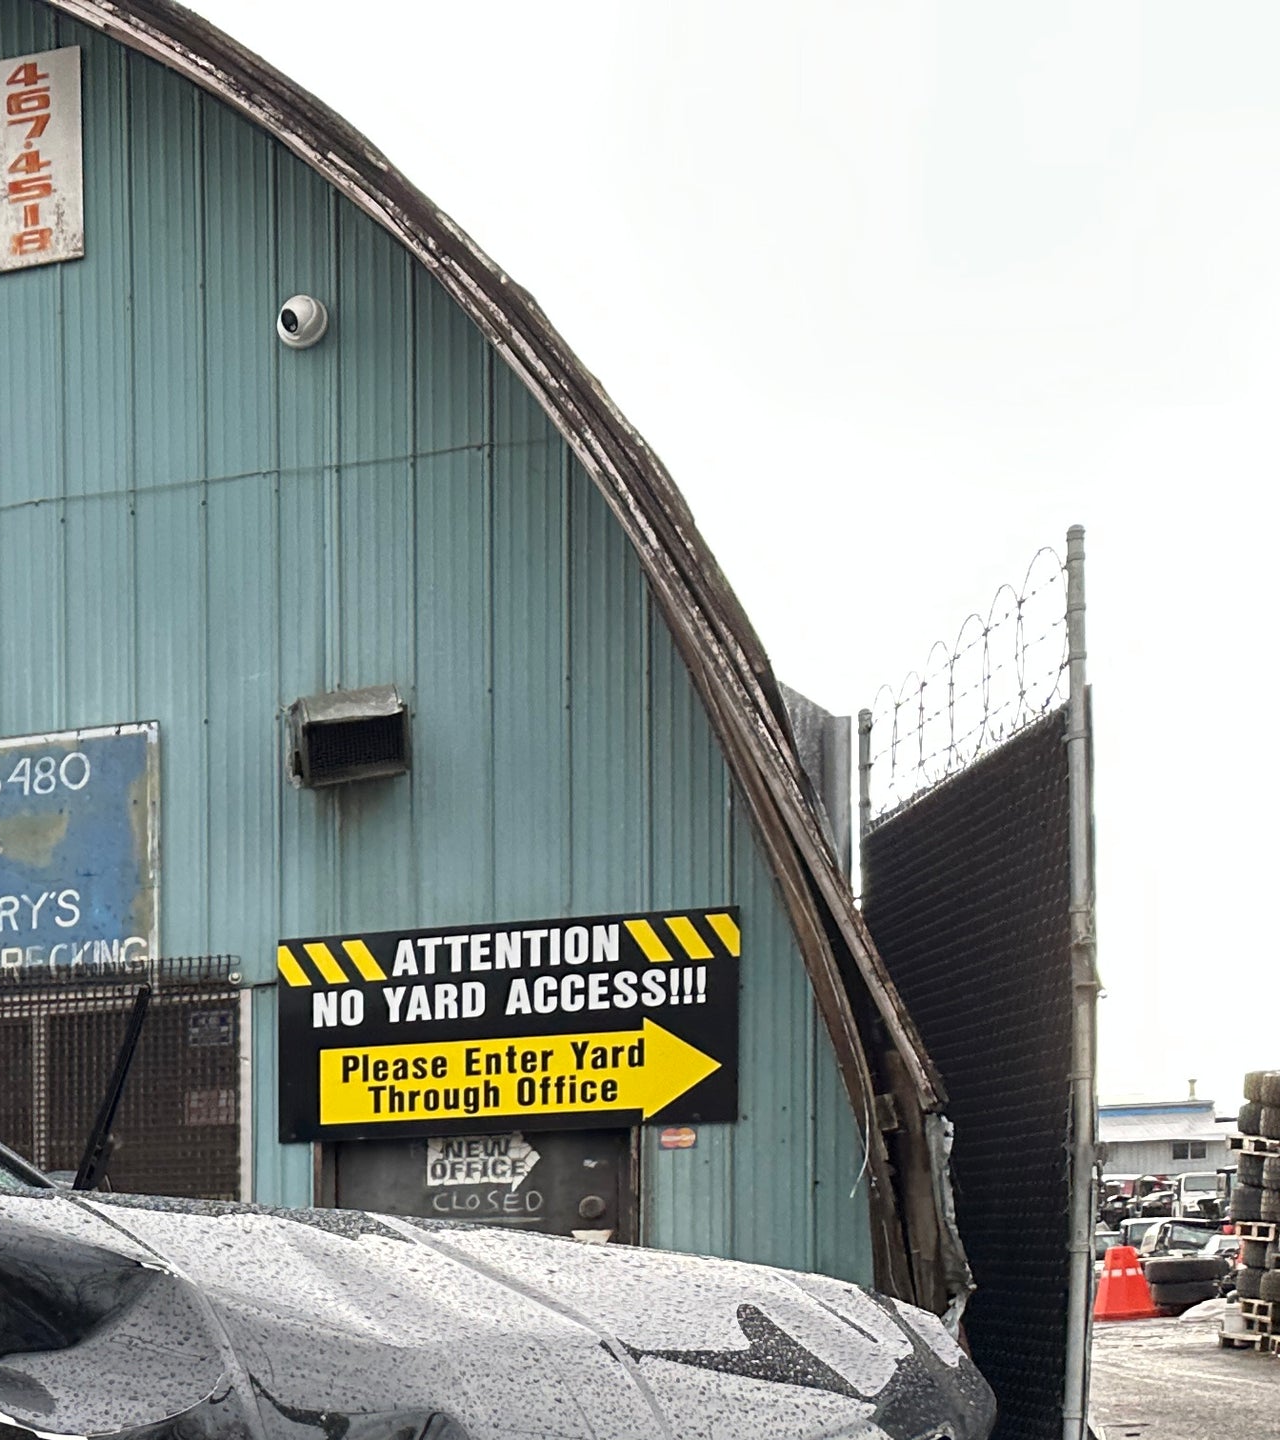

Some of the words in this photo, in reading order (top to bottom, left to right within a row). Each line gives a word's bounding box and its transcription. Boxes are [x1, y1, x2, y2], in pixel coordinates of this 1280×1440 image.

[392, 923, 620, 977] ATTENTION
[312, 989, 365, 1028] NO
[383, 981, 487, 1023] YARD
[505, 966, 708, 1016] ACCESS!!!
[341, 1052, 448, 1083] Please
[465, 1046, 555, 1076] Enter
[570, 1037, 646, 1070] Yard
[367, 1076, 500, 1115] Through
[517, 1074, 619, 1107] Office
[443, 1137, 510, 1159] NEW
[430, 1158, 527, 1181] OFFICE
[432, 1189, 544, 1213] CLOSED
